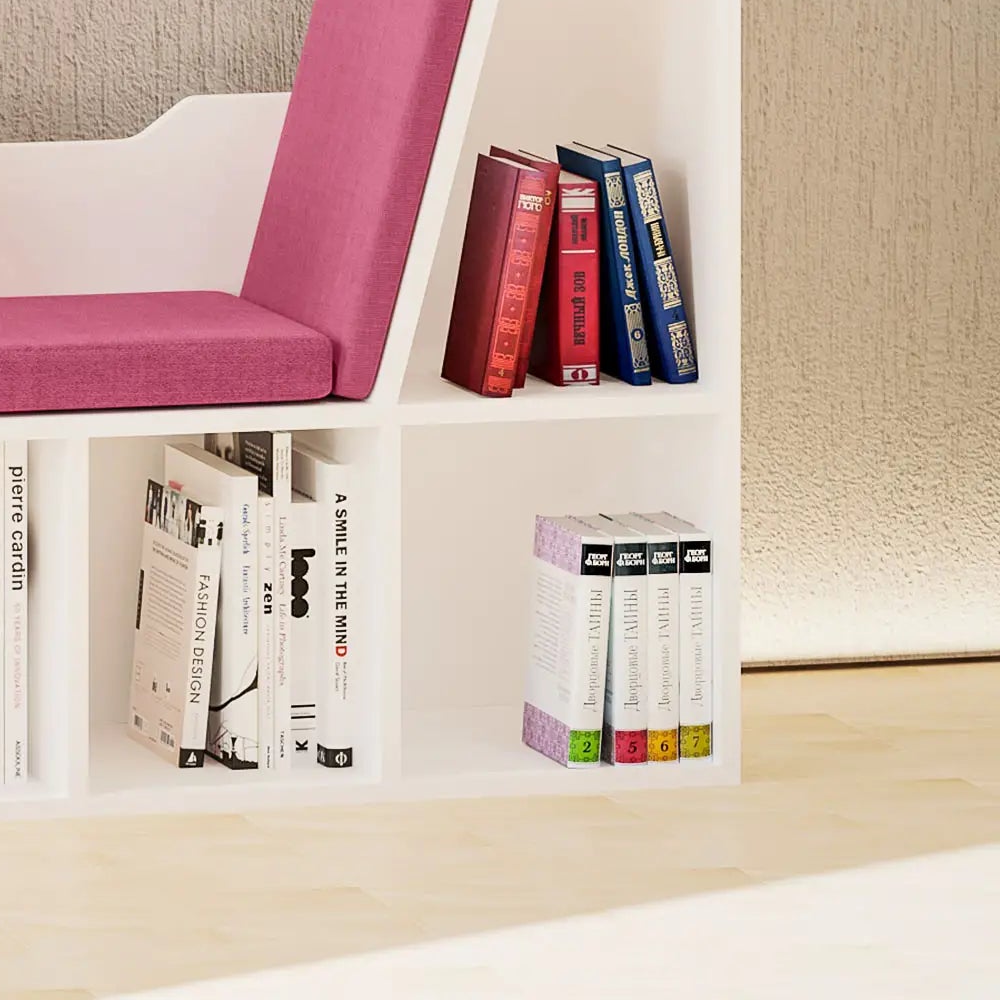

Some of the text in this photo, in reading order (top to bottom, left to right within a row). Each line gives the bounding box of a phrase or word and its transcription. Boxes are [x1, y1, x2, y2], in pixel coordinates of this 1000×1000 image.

[613, 210, 630, 263] ЛОНДОН
[573, 271, 586, 293] ЗОВ
[335, 493, 347, 503] A
[8, 466, 26, 591] pierre cardin
[335, 509, 347, 556] SMILE
[335, 561, 347, 577] IN
[195, 574, 211, 641] FASHION
[263, 582, 272, 614] zen
[335, 582, 347, 610] THE
[335, 615, 347, 658] MIND
[190, 647, 205, 704] DESIGN
[582, 741, 591, 753] 2
[627, 741, 638, 754] 5
[660, 740, 669, 752] 6
[692, 736, 700, 748] 7
